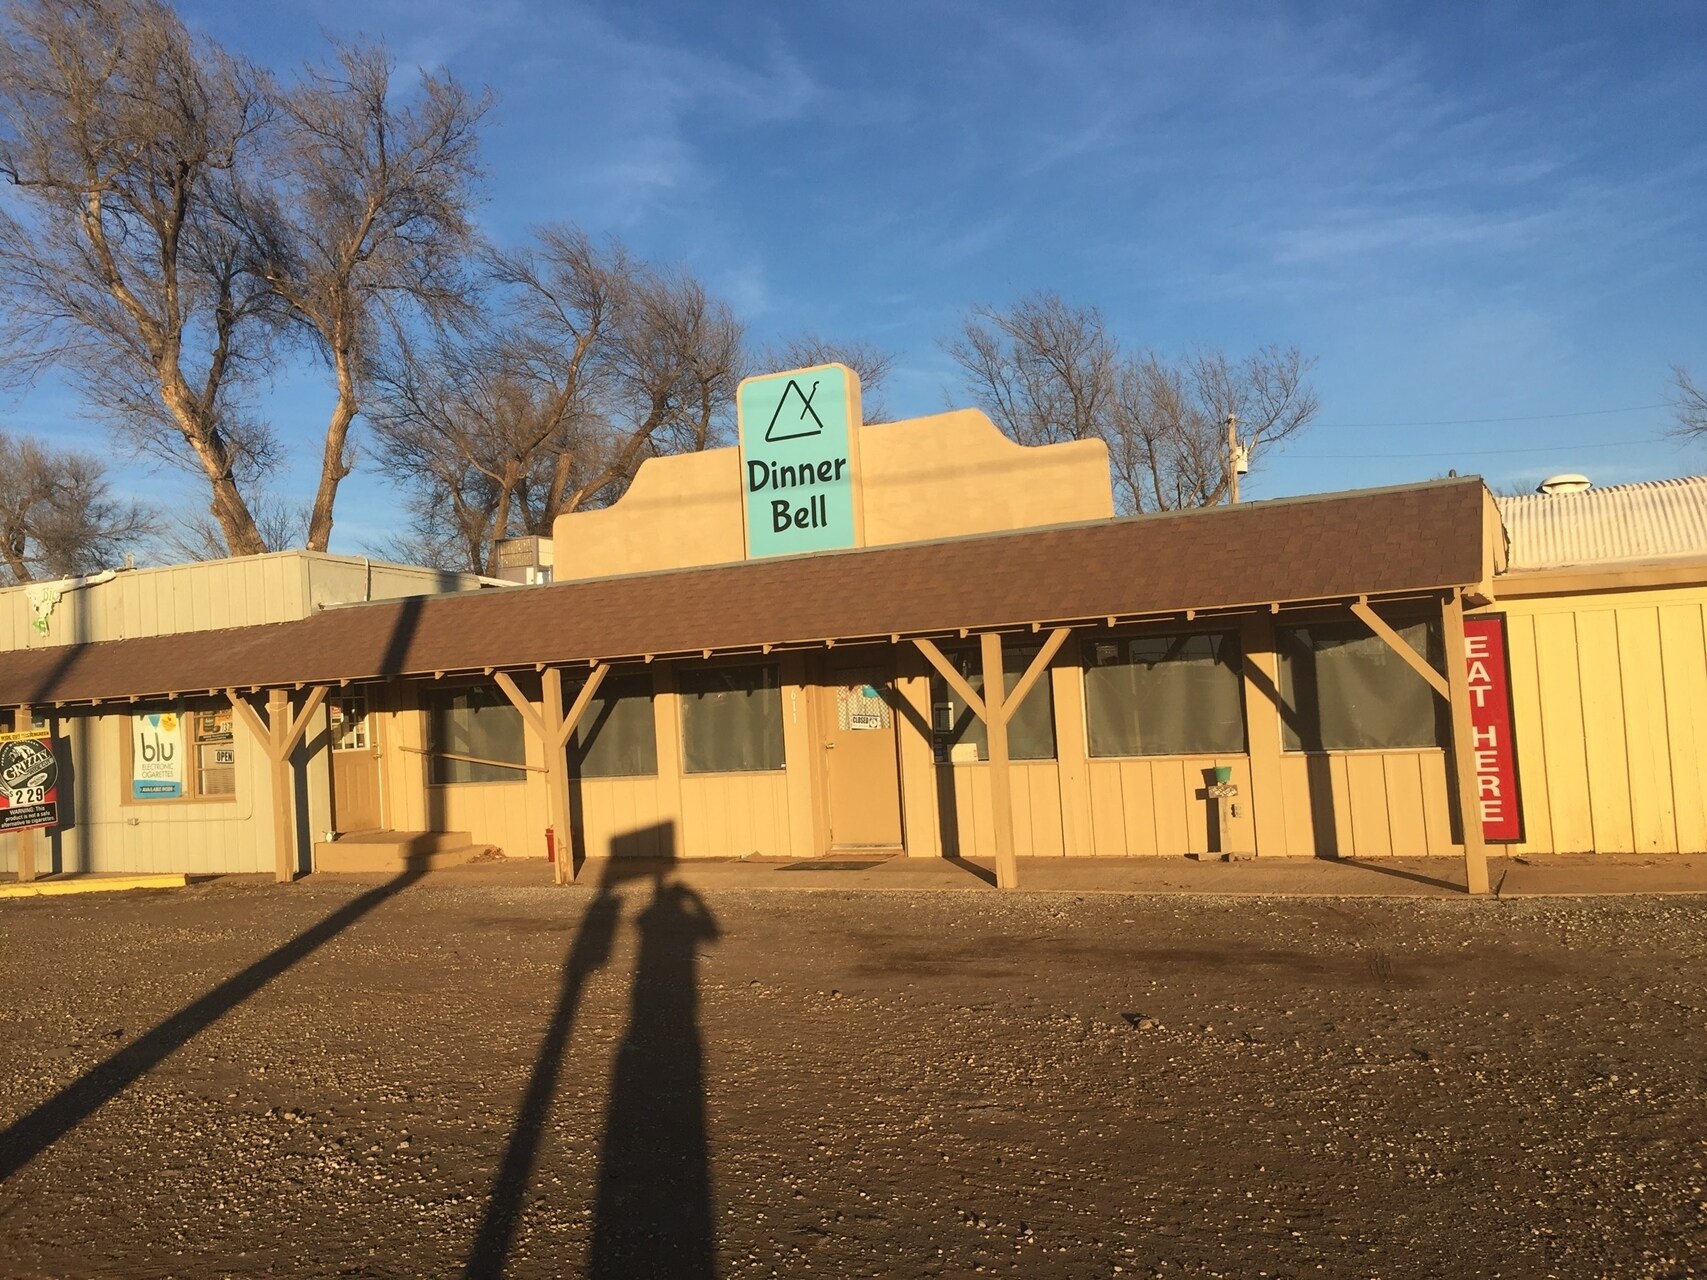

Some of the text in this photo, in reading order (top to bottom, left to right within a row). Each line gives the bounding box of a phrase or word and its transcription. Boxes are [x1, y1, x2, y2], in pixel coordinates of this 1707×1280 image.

[747, 458, 847, 492] Dinner
[770, 494, 828, 533] Bell
[852, 716, 869, 724] CLOSED
[1464, 635, 1504, 822] EAT HERE
[141, 732, 173, 762] blu
[216, 751, 233, 762] OPEN
[3, 749, 49, 780] GRIZZLY
[142, 763, 173, 771] ELECTRONIC
